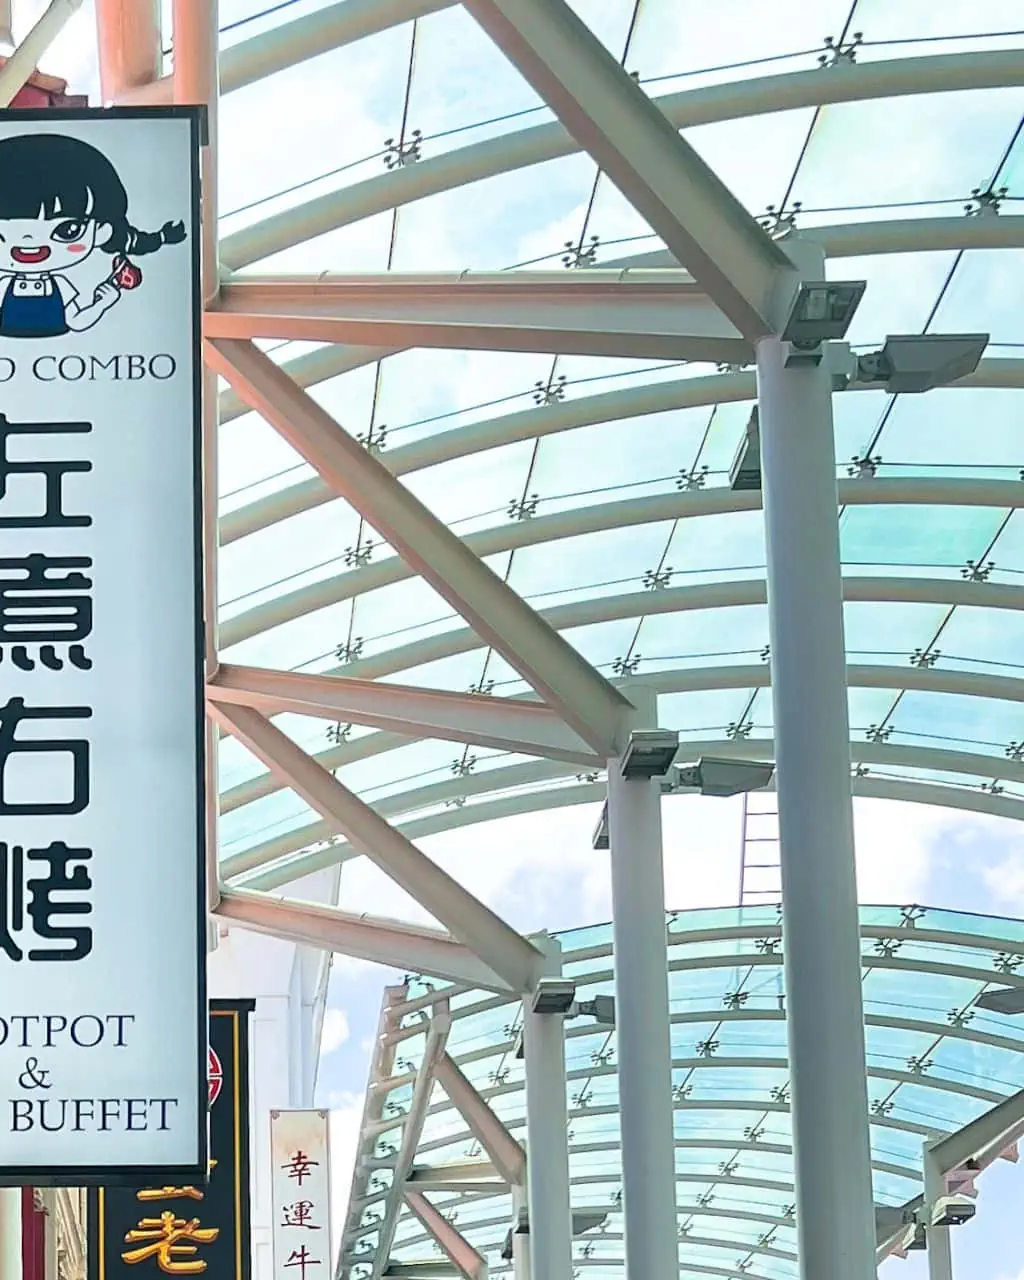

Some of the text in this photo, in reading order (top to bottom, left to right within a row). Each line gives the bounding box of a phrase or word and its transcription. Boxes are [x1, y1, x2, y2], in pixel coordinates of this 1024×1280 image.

[32, 353, 177, 383] COMBO
[17, 1056, 53, 1090] &
[9, 1098, 178, 1132] BUFFET
